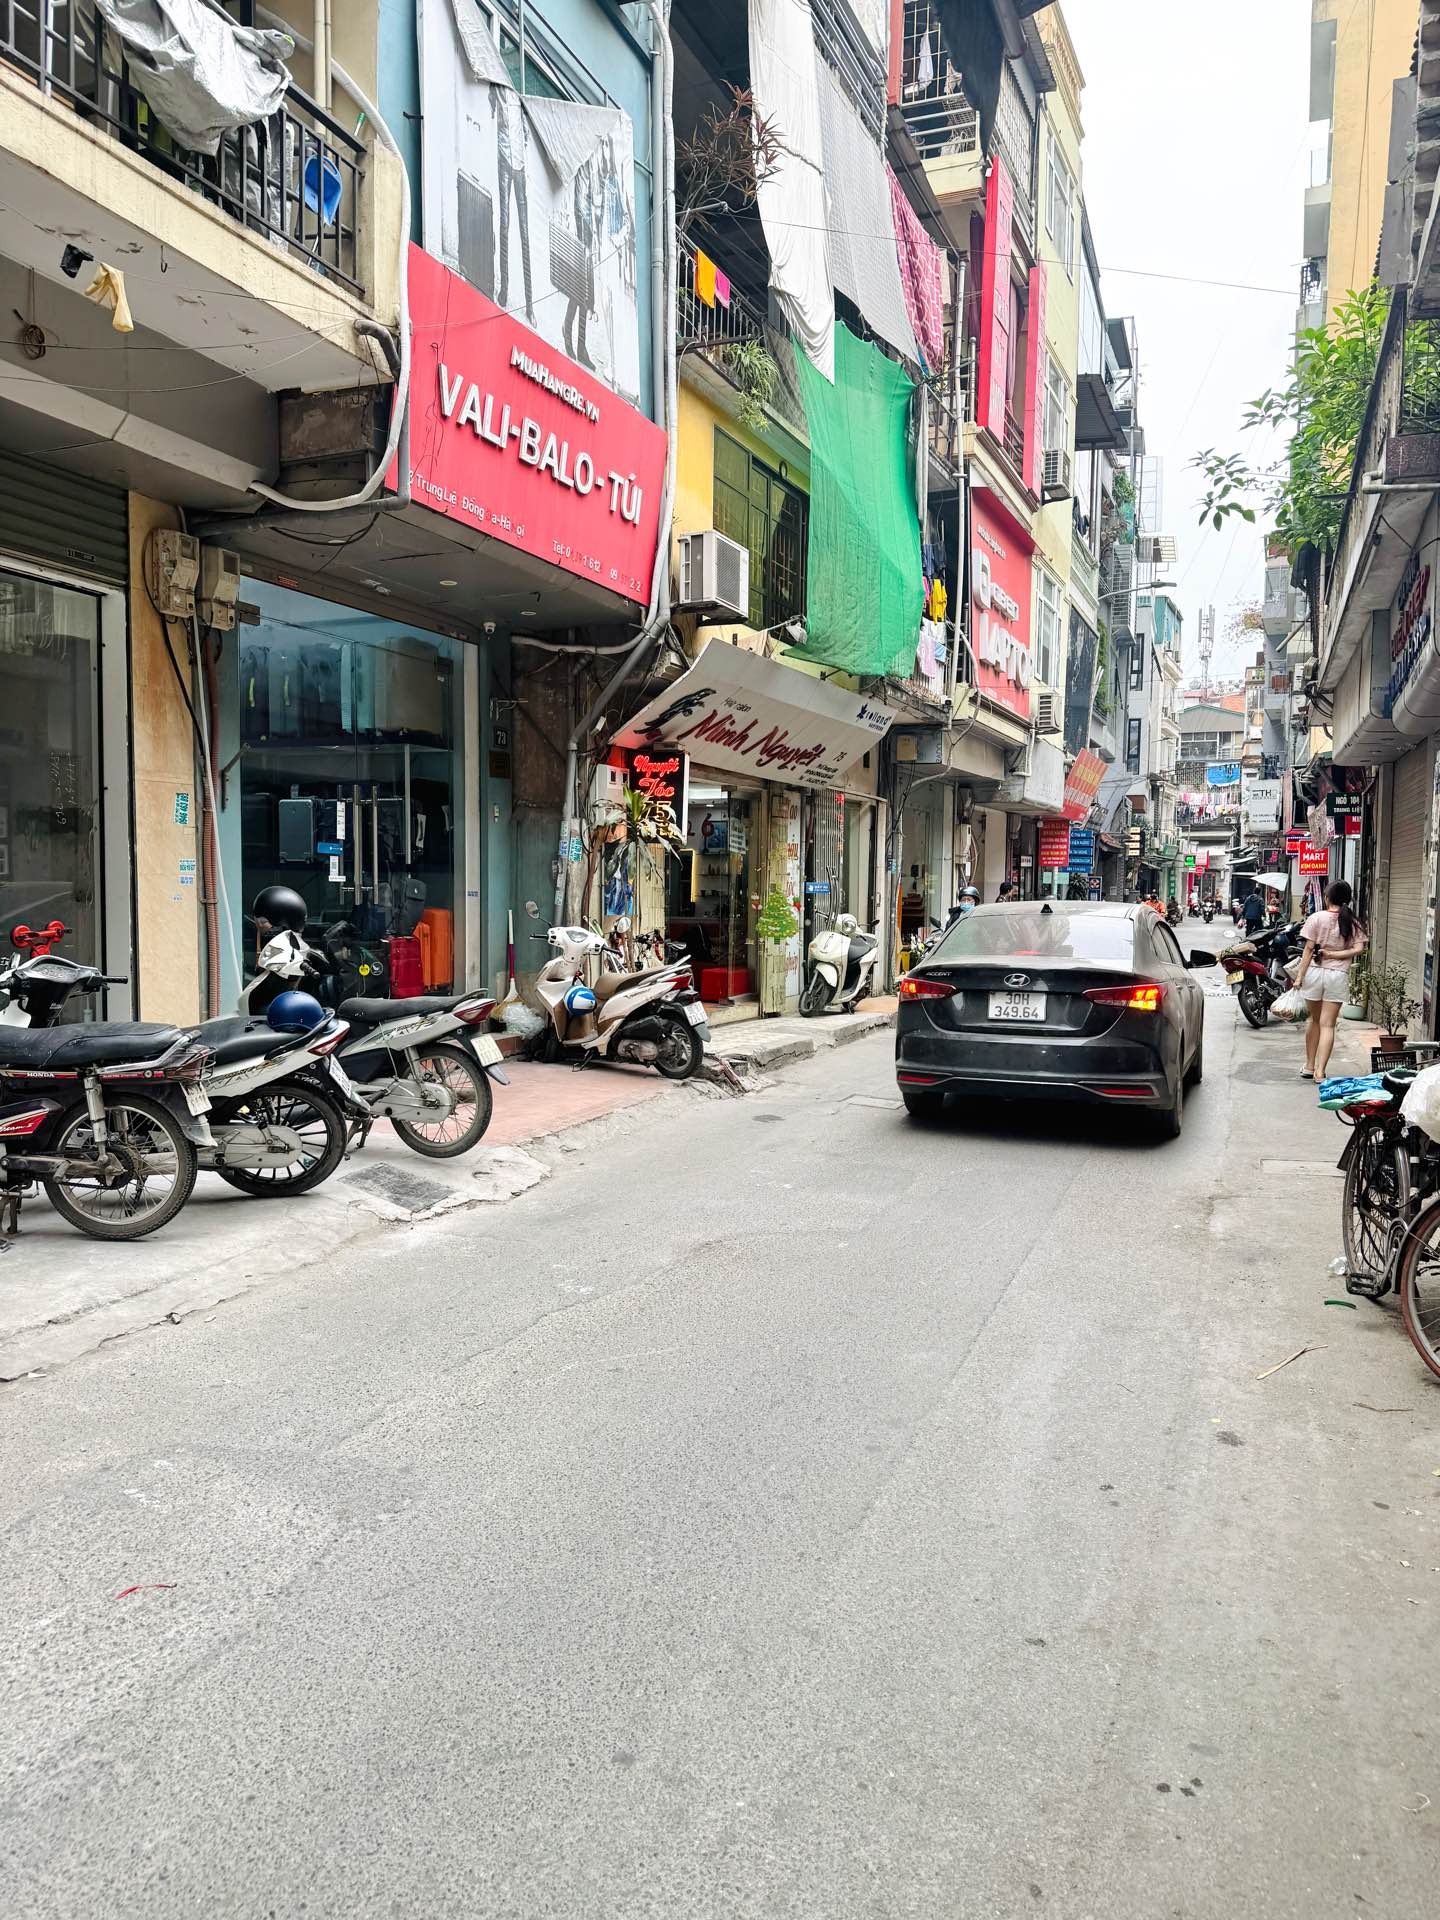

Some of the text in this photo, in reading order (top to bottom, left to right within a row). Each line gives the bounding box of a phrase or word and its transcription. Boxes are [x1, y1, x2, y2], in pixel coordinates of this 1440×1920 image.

[676, 708, 826, 771] Minh Nguyệt
[1303, 852, 1325, 861] MART
[1005, 993, 1030, 1005] 30H
[994, 1006, 1039, 1018] 349.64
